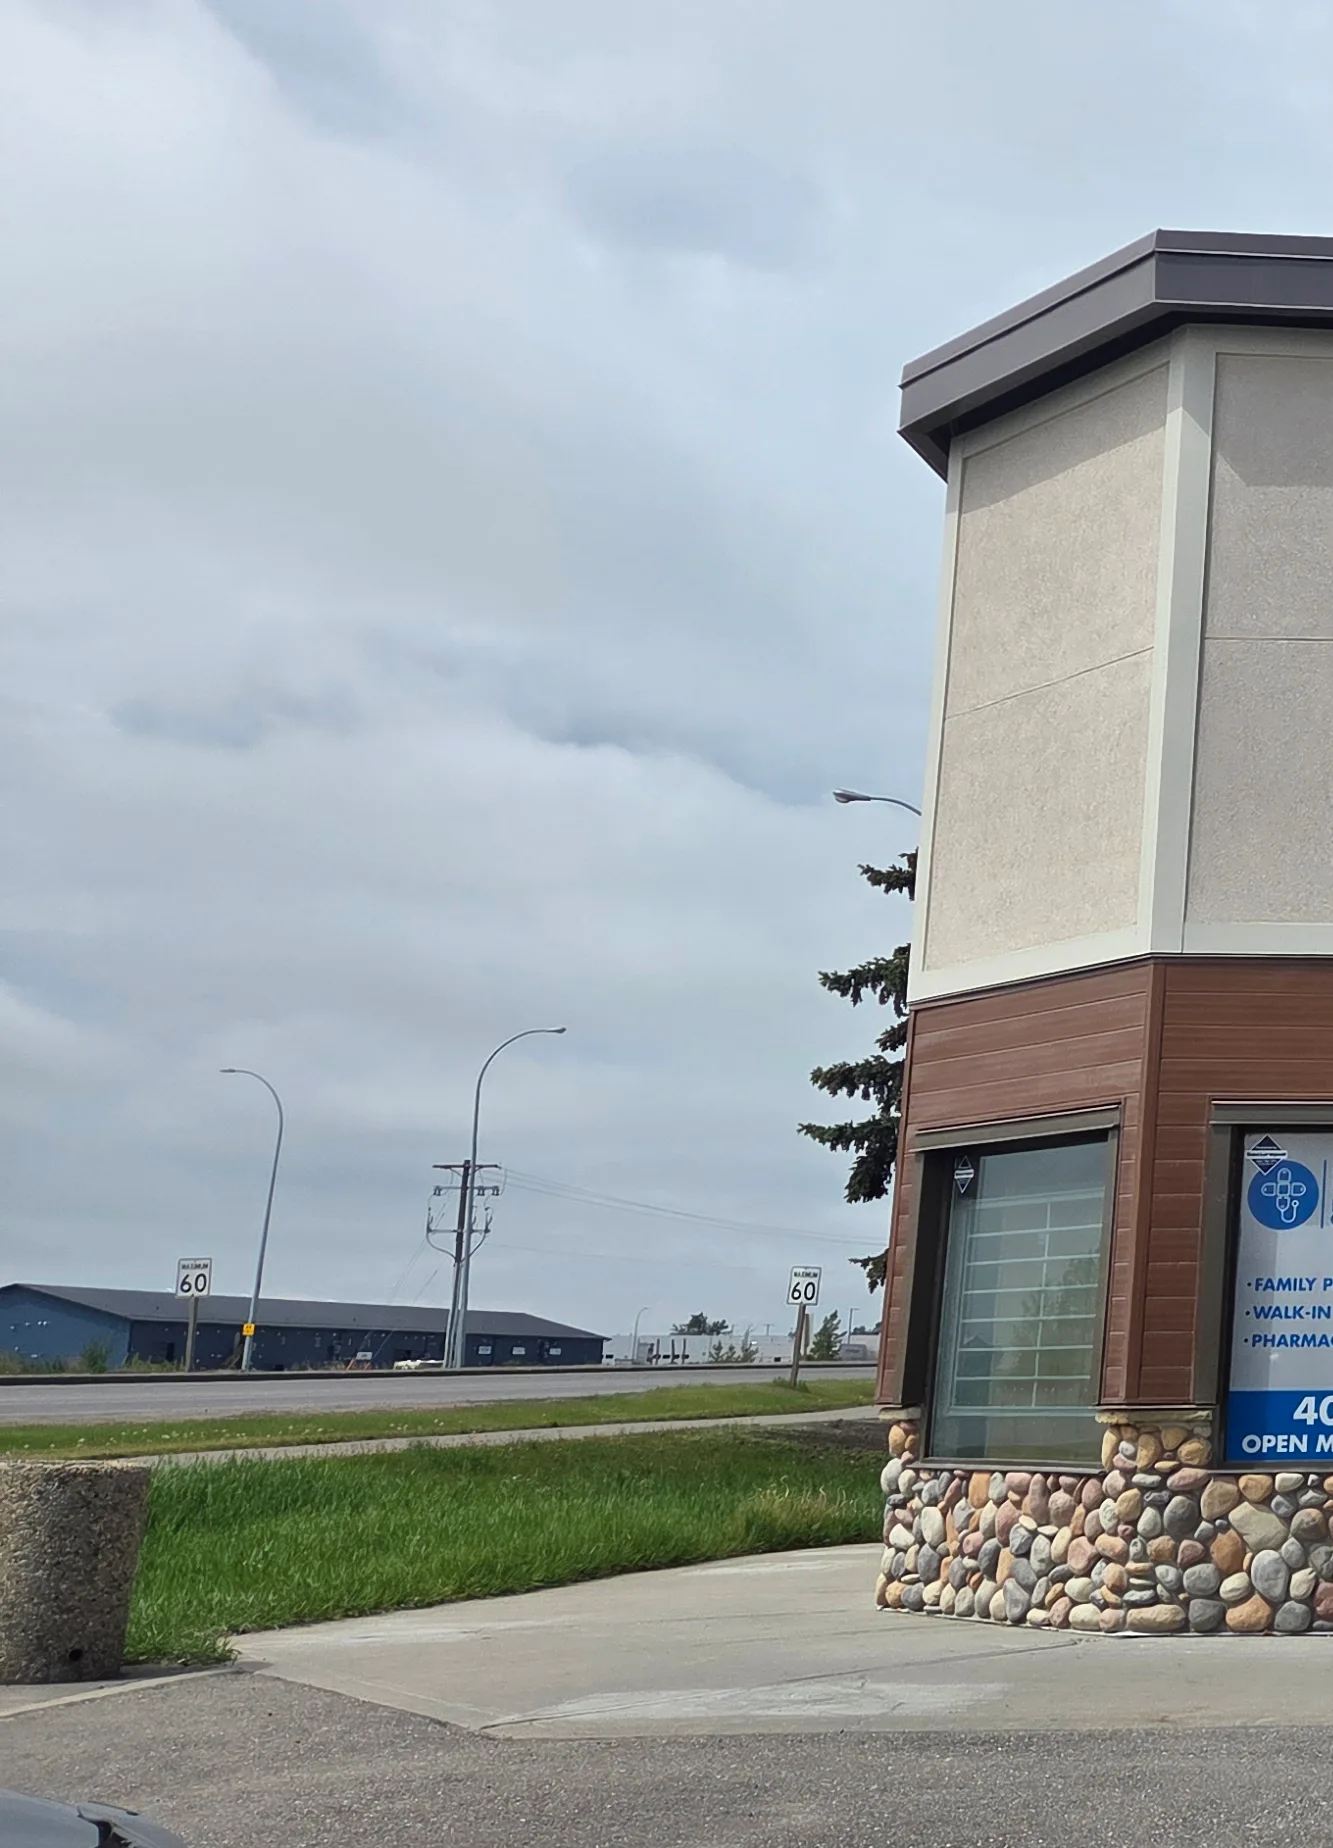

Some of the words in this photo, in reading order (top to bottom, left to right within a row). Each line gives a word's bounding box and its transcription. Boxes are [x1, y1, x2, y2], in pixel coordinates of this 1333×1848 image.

[180, 1273, 207, 1293] 60
[791, 1282, 816, 1301] 60
[1254, 1277, 1316, 1292] FAMILY
[1253, 1305, 1331, 1320] WALK-IN
[1241, 1433, 1307, 1454] OPEN
